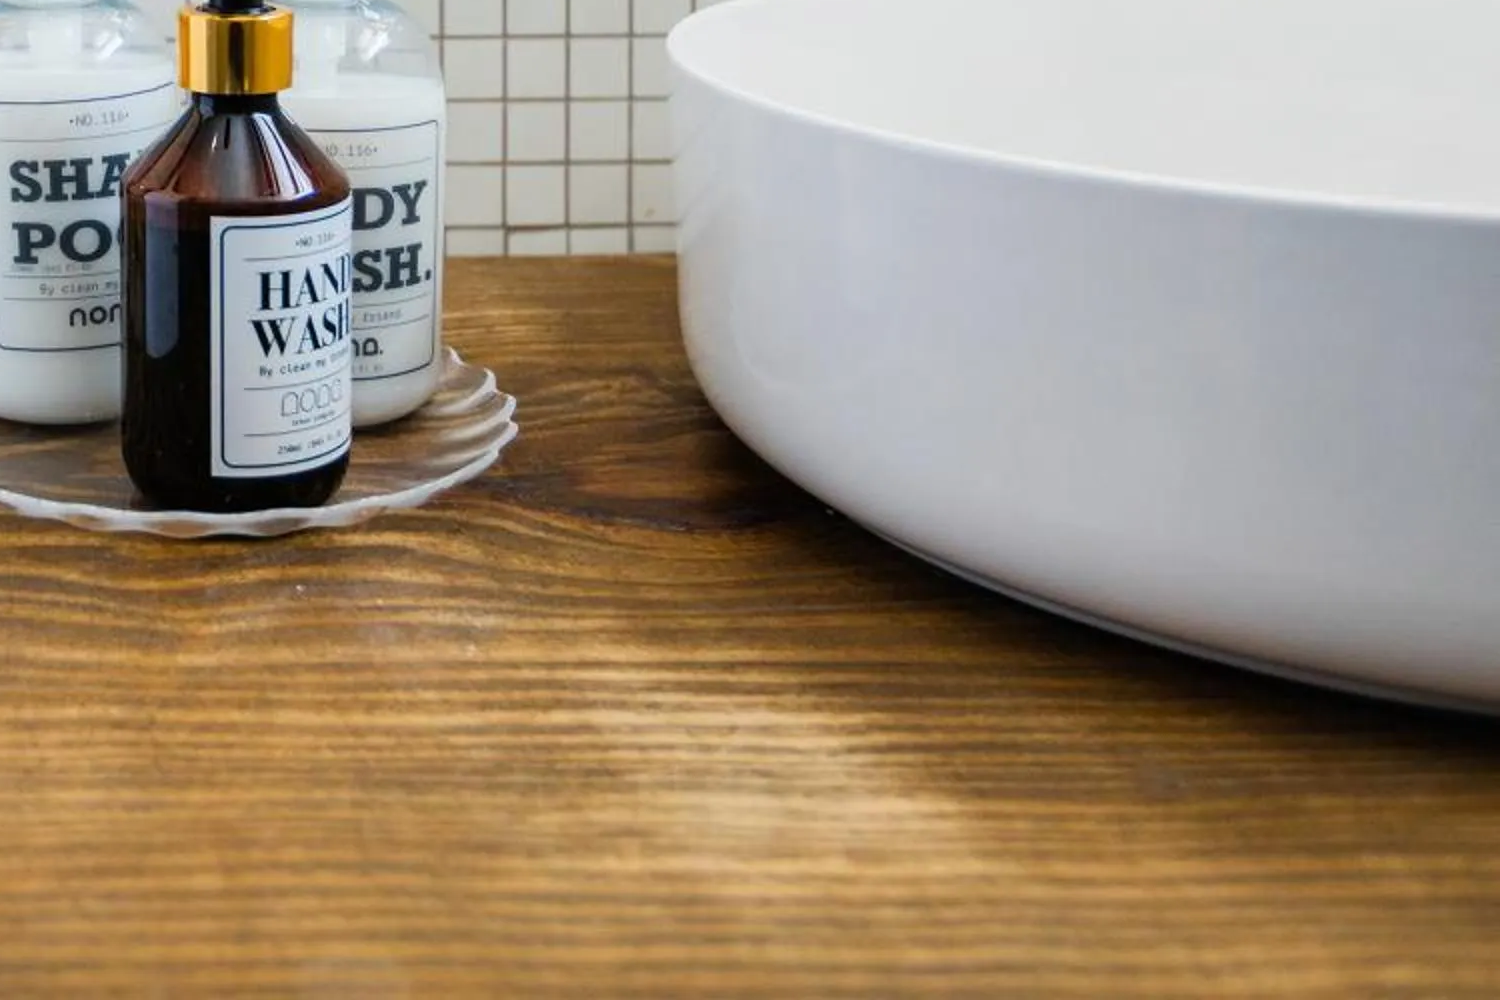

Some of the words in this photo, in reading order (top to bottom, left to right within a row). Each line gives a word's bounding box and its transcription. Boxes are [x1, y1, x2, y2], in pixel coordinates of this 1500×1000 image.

[351, 180, 428, 231] DY
[11, 219, 123, 265] PO
[351, 243, 432, 293] SH.
